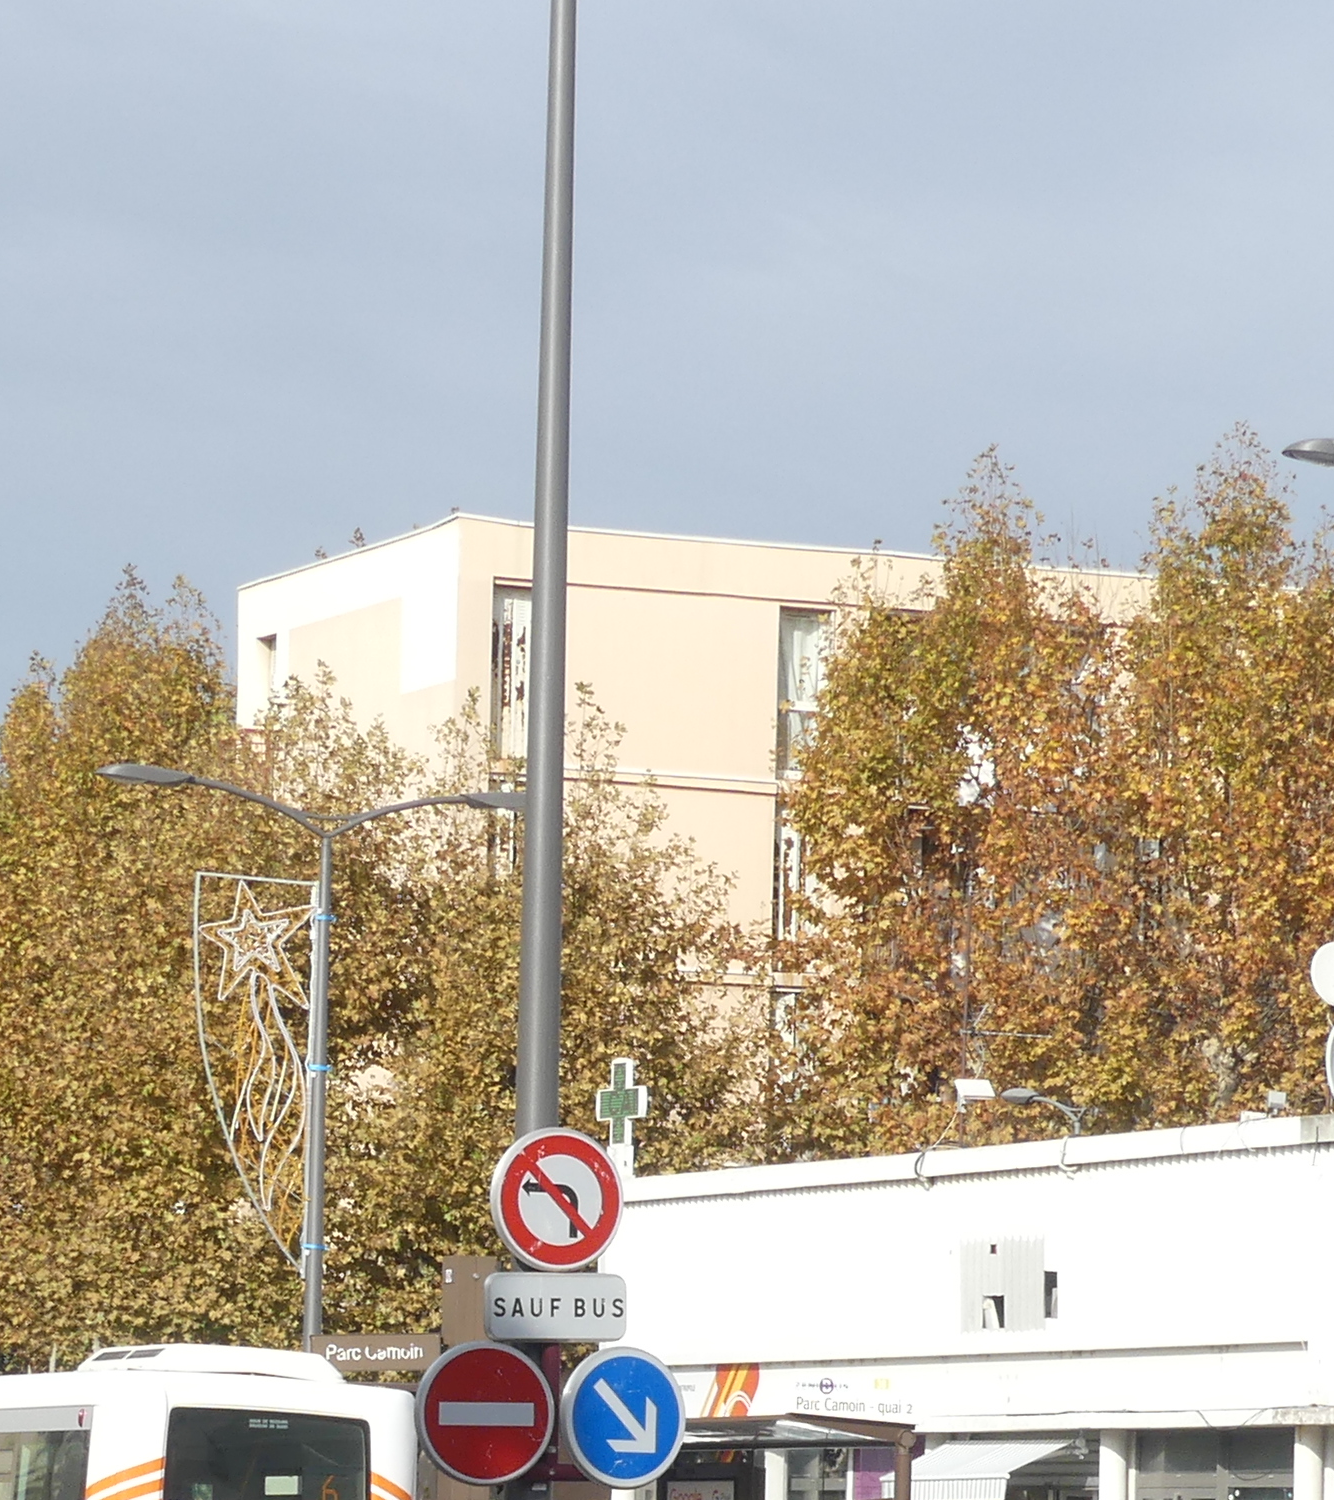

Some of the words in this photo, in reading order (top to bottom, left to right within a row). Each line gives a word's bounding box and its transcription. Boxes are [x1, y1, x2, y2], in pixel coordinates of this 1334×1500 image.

[494, 1297, 562, 1318] SAUF
[574, 1297, 625, 1319] BUS
[325, 1343, 362, 1362] Parc
[796, 1396, 820, 1411] Parc
[824, 1396, 866, 1413] Camoin
[878, 1400, 902, 1415] quai
[906, 1403, 913, 1414] 2
